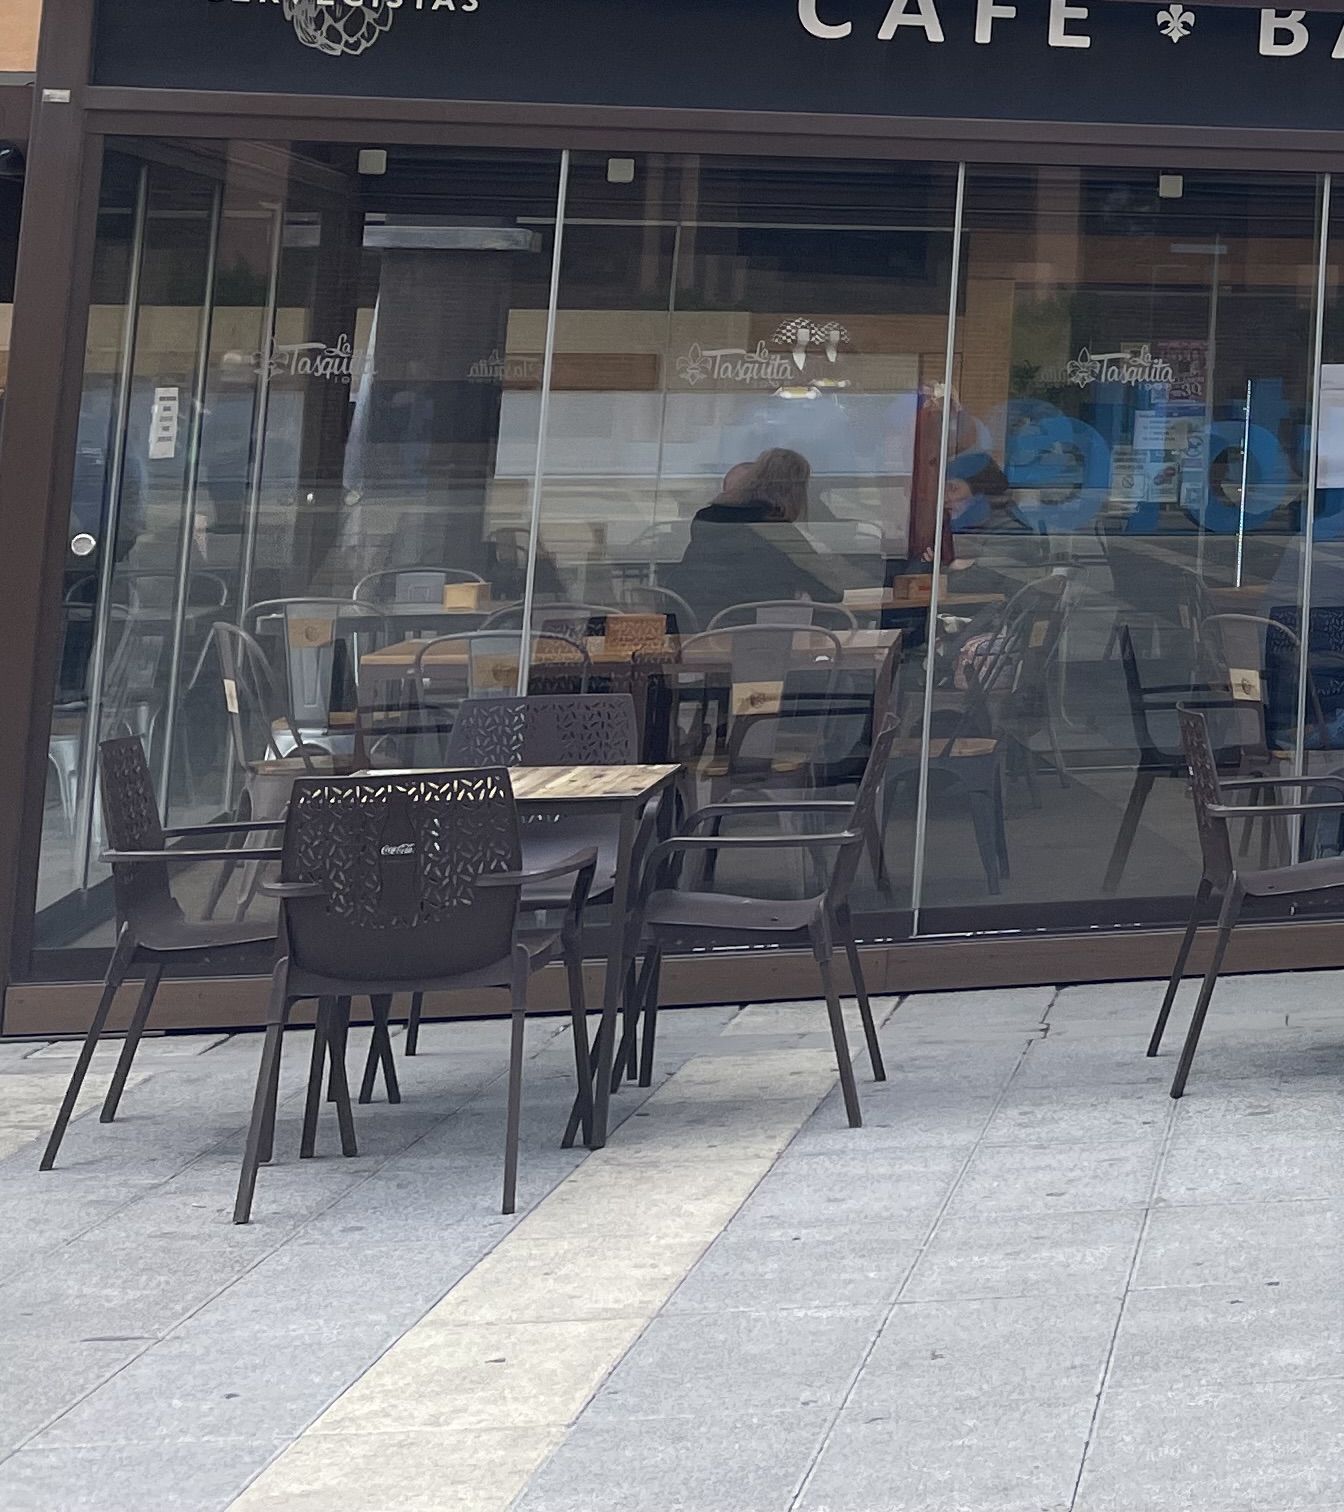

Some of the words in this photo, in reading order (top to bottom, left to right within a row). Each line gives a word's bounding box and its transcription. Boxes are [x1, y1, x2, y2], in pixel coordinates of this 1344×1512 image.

[702, 348, 794, 383] Tasquita
[1090, 352, 1175, 385] Tasquita
[1130, 345, 1152, 364] La
